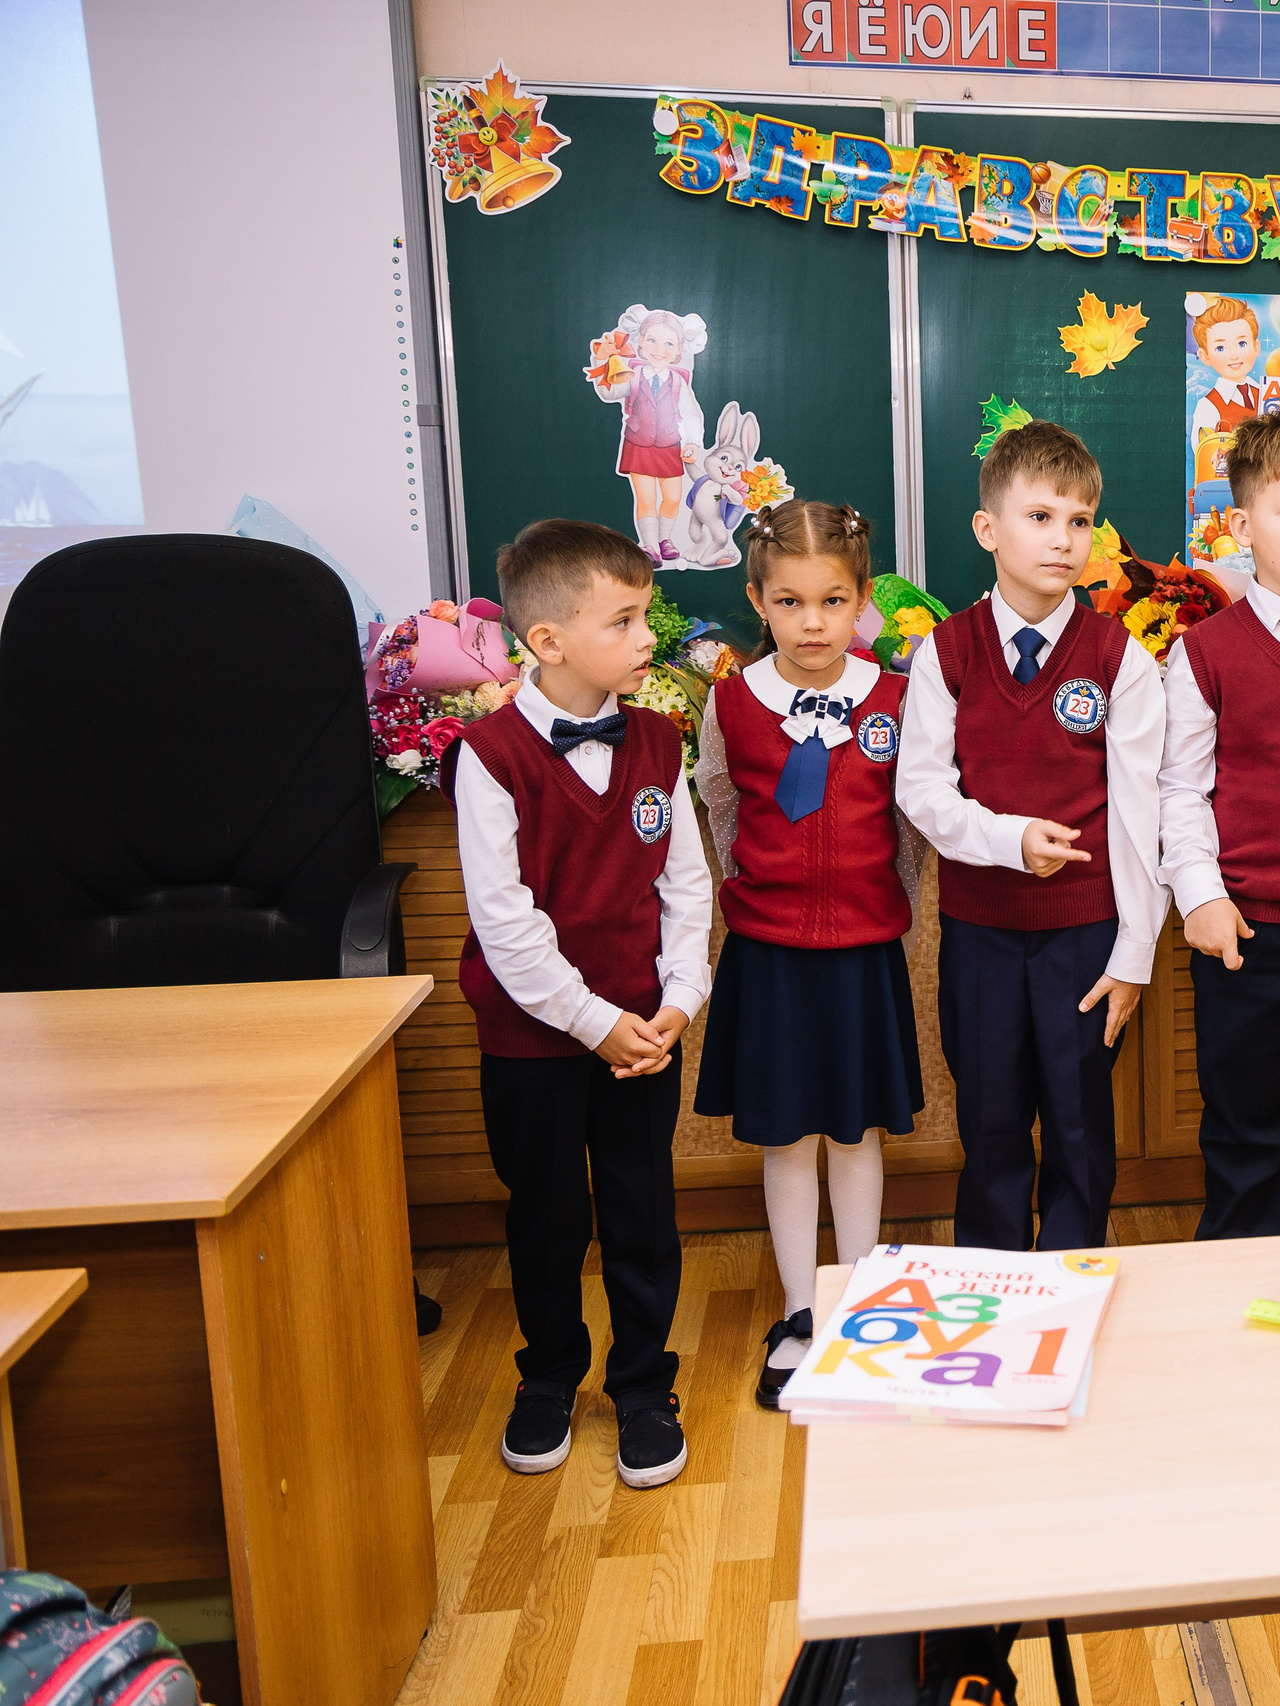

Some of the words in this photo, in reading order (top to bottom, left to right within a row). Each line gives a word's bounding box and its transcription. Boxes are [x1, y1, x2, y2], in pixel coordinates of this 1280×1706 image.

[1070, 698, 1090, 715] 23
[871, 730, 888, 745] 23
[642, 808, 657, 825] 23
[901, 1260, 1034, 1282] Русский
[1012, 1326, 1069, 1378] 1
